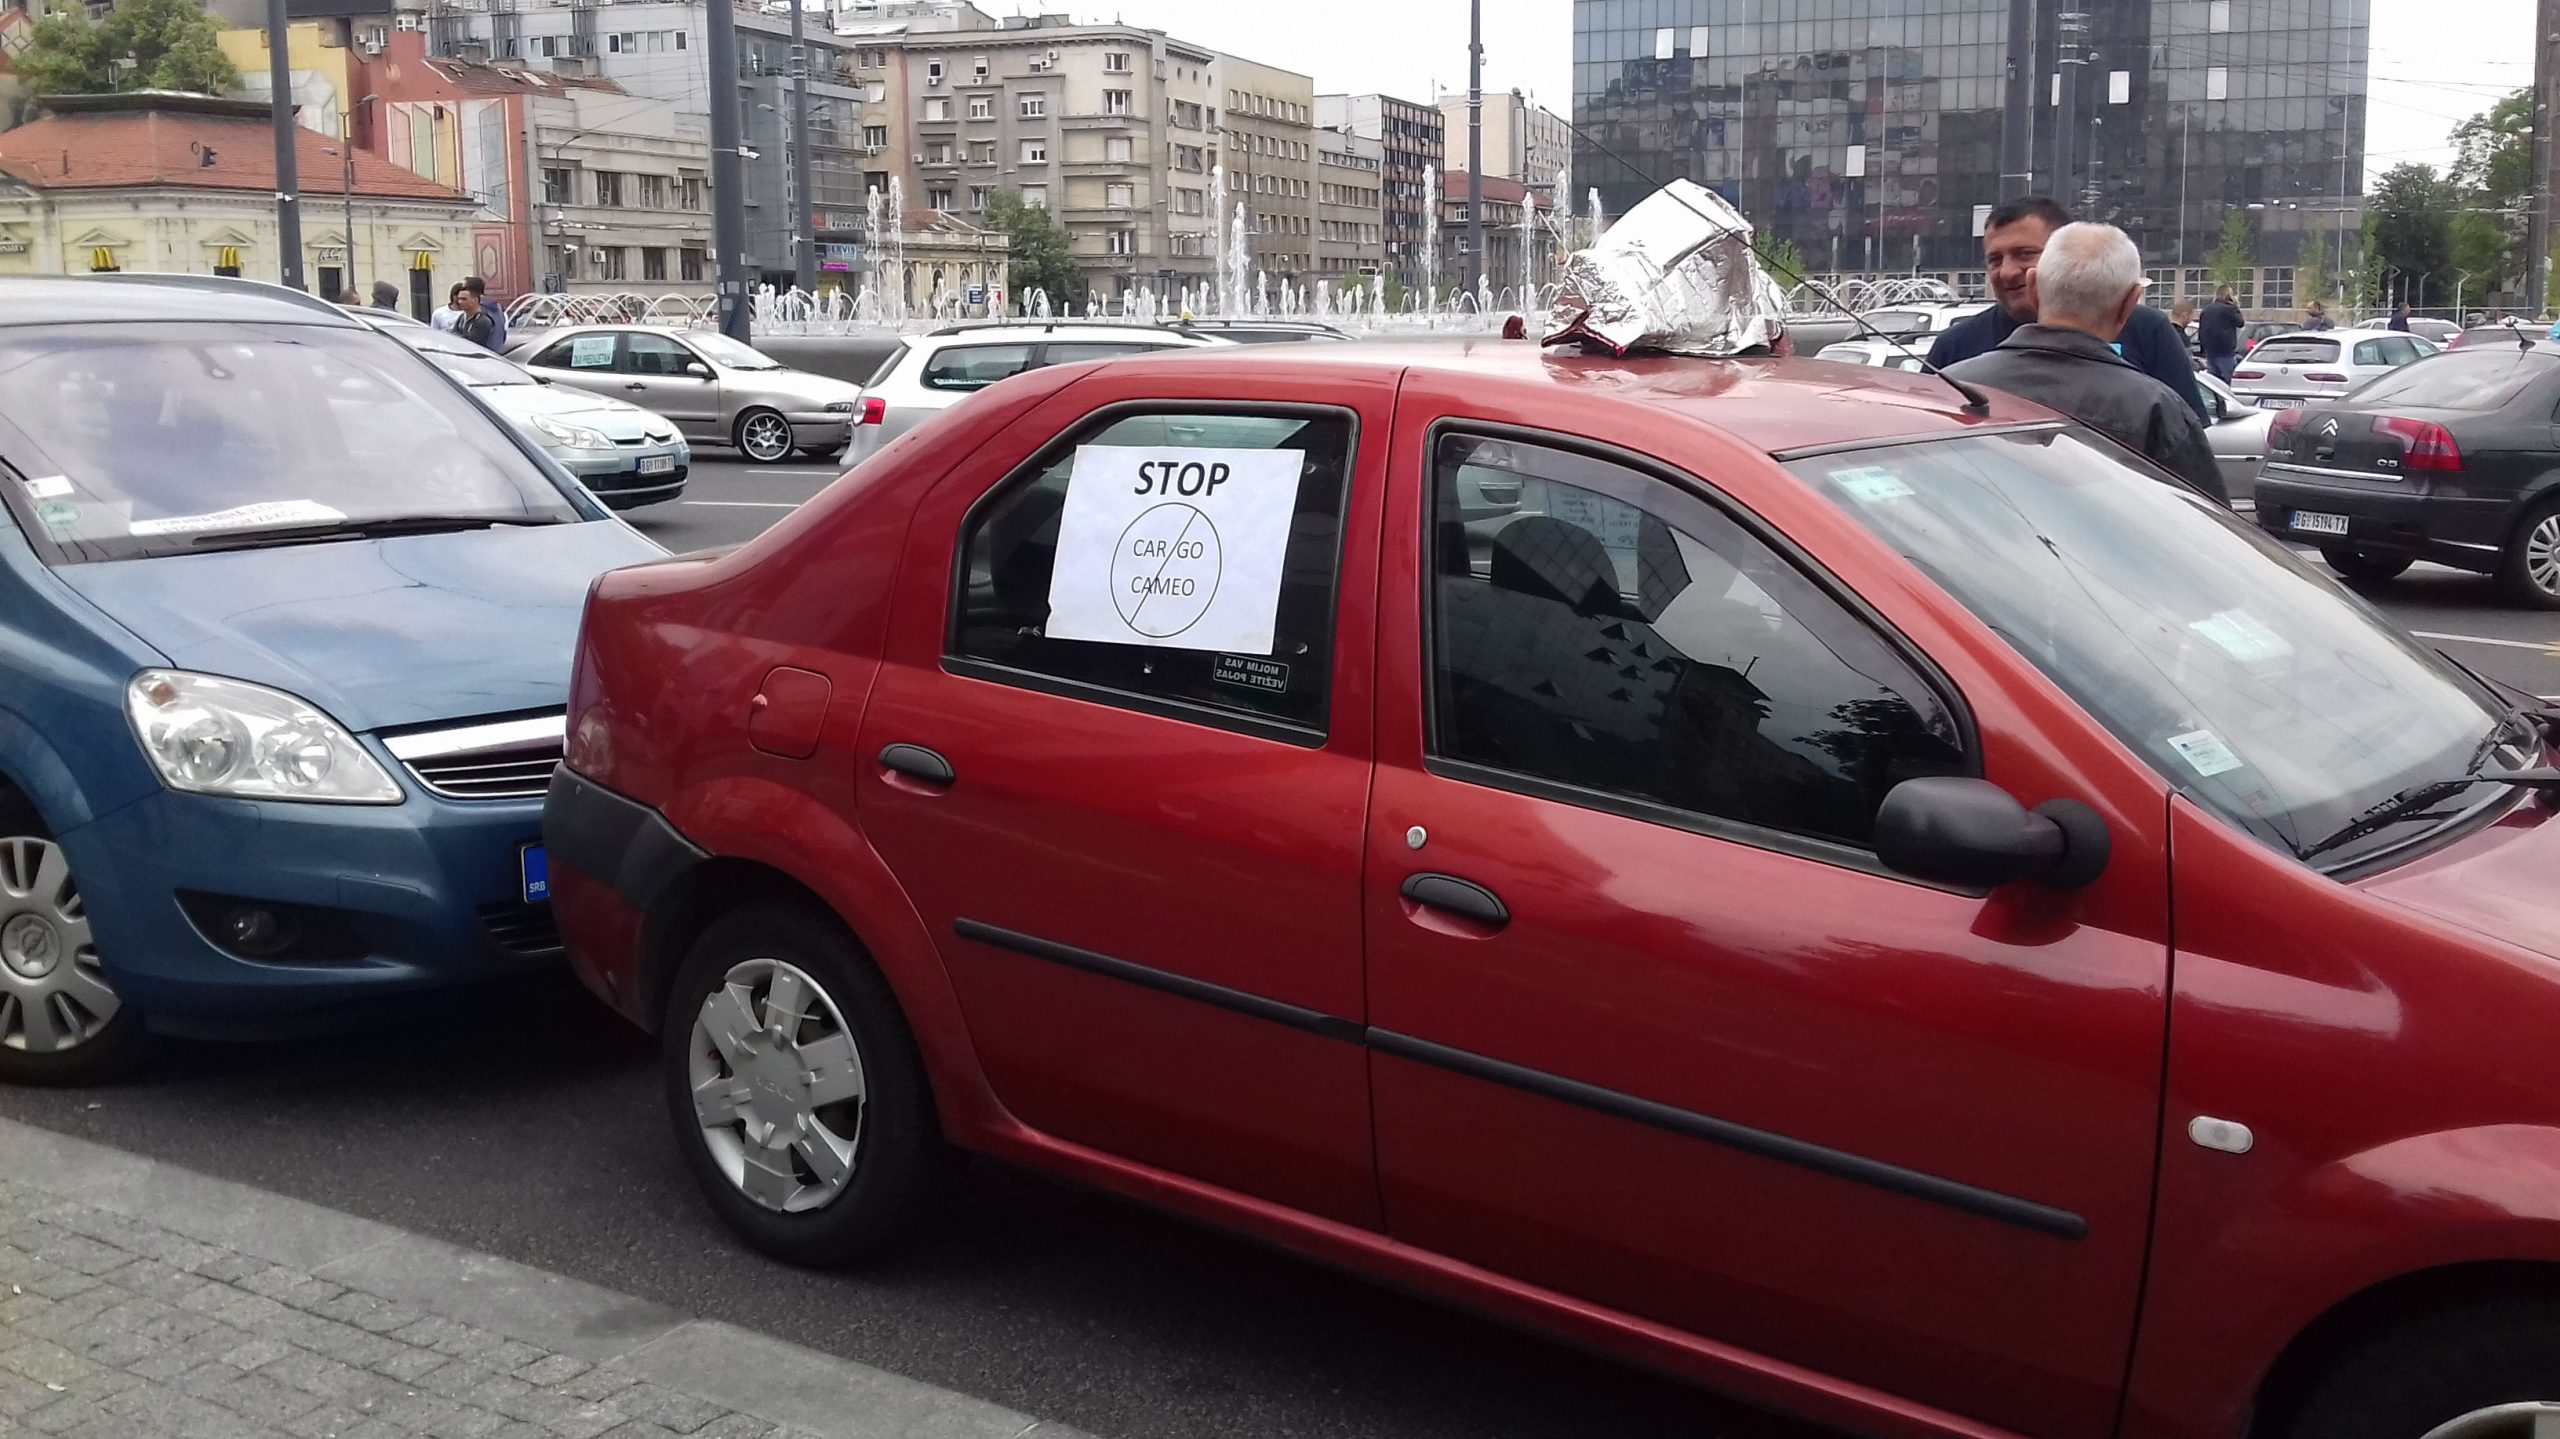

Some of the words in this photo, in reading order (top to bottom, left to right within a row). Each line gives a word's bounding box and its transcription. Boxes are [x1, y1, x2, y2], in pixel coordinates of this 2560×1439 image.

[1134, 461, 1230, 496] STOP
[2295, 512, 2307, 527] BG
[1133, 539, 1167, 558] CAR
[1176, 541, 1204, 559] GO
[1131, 576, 1195, 597] CAMEO
[529, 881, 546, 893] SRB
